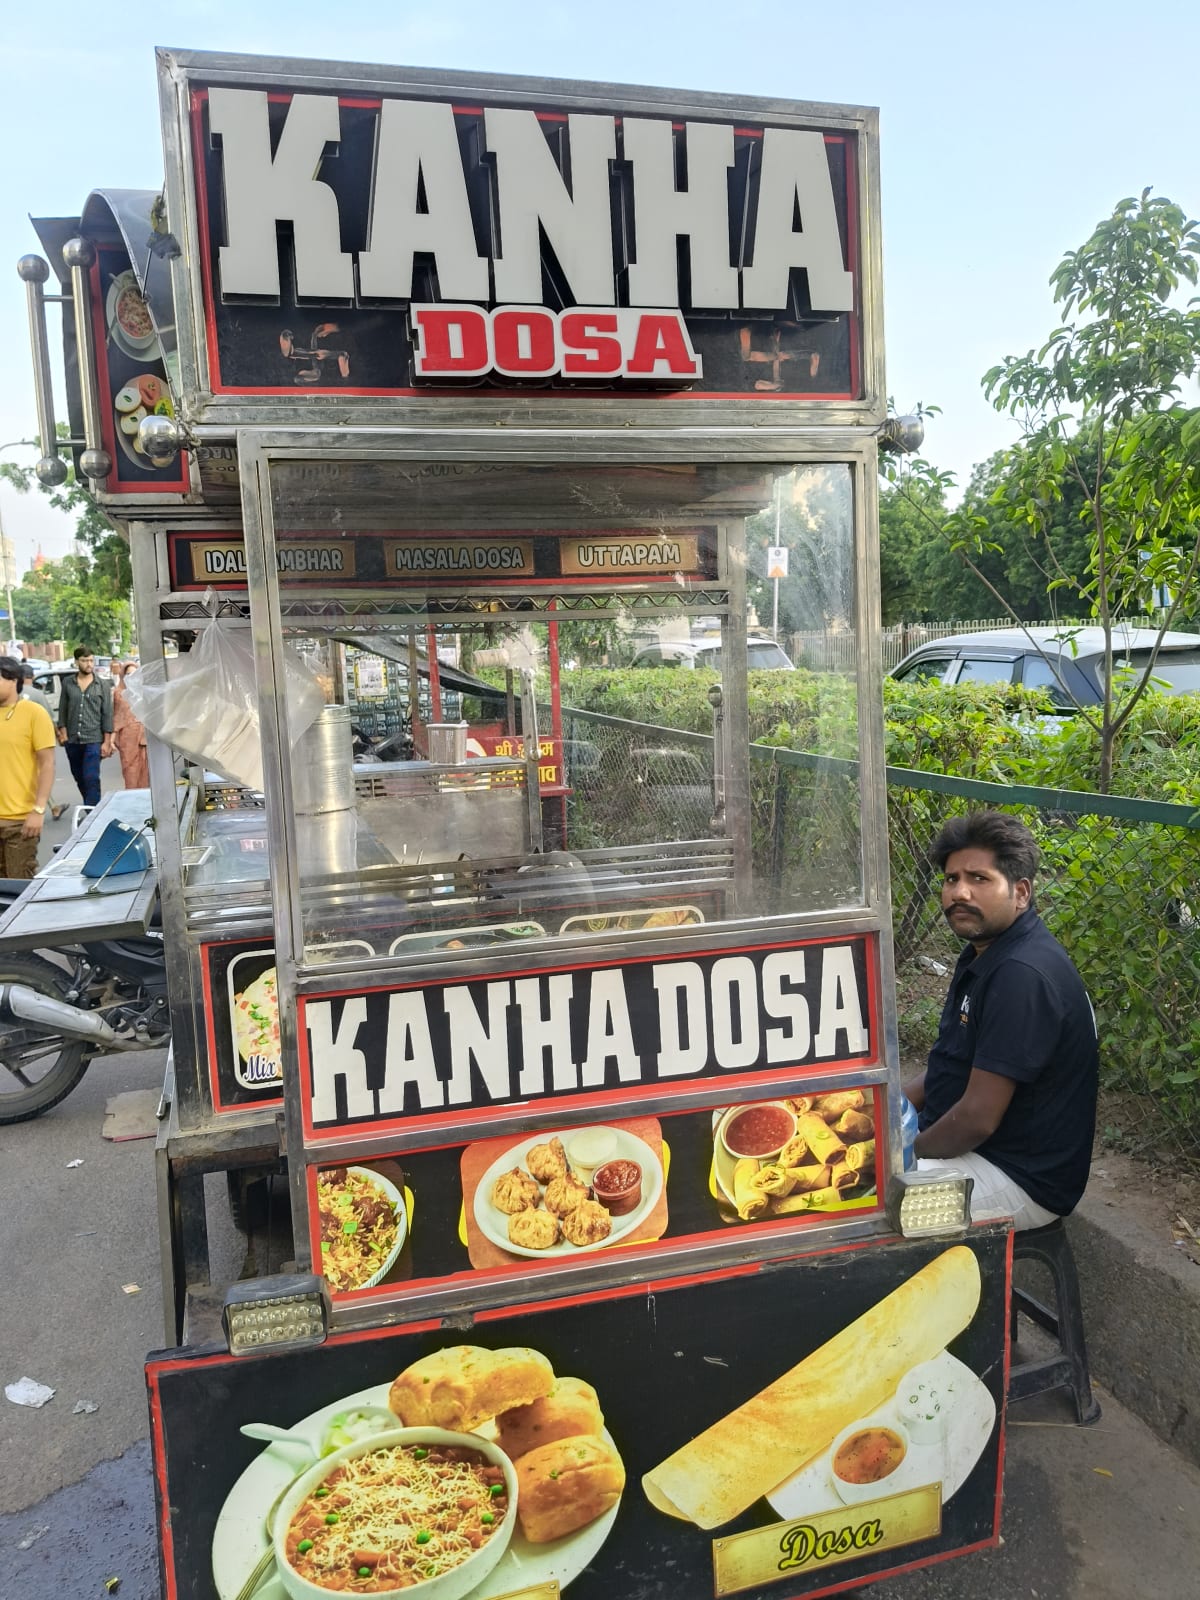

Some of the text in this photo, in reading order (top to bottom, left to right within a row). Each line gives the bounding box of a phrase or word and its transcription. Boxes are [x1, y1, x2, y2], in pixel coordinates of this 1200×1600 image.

[207, 86, 853, 311] KANHA
[411, 303, 702, 378] DOSA
[205, 550, 247, 573] IDAL
[396, 546, 526, 571] MASALA DOSA
[577, 543, 681, 568] UTTAPAM
[306, 946, 869, 1122] KANHA DOSA
[243, 1054, 277, 1081] Mix
[779, 1518, 884, 1570] Dosa
